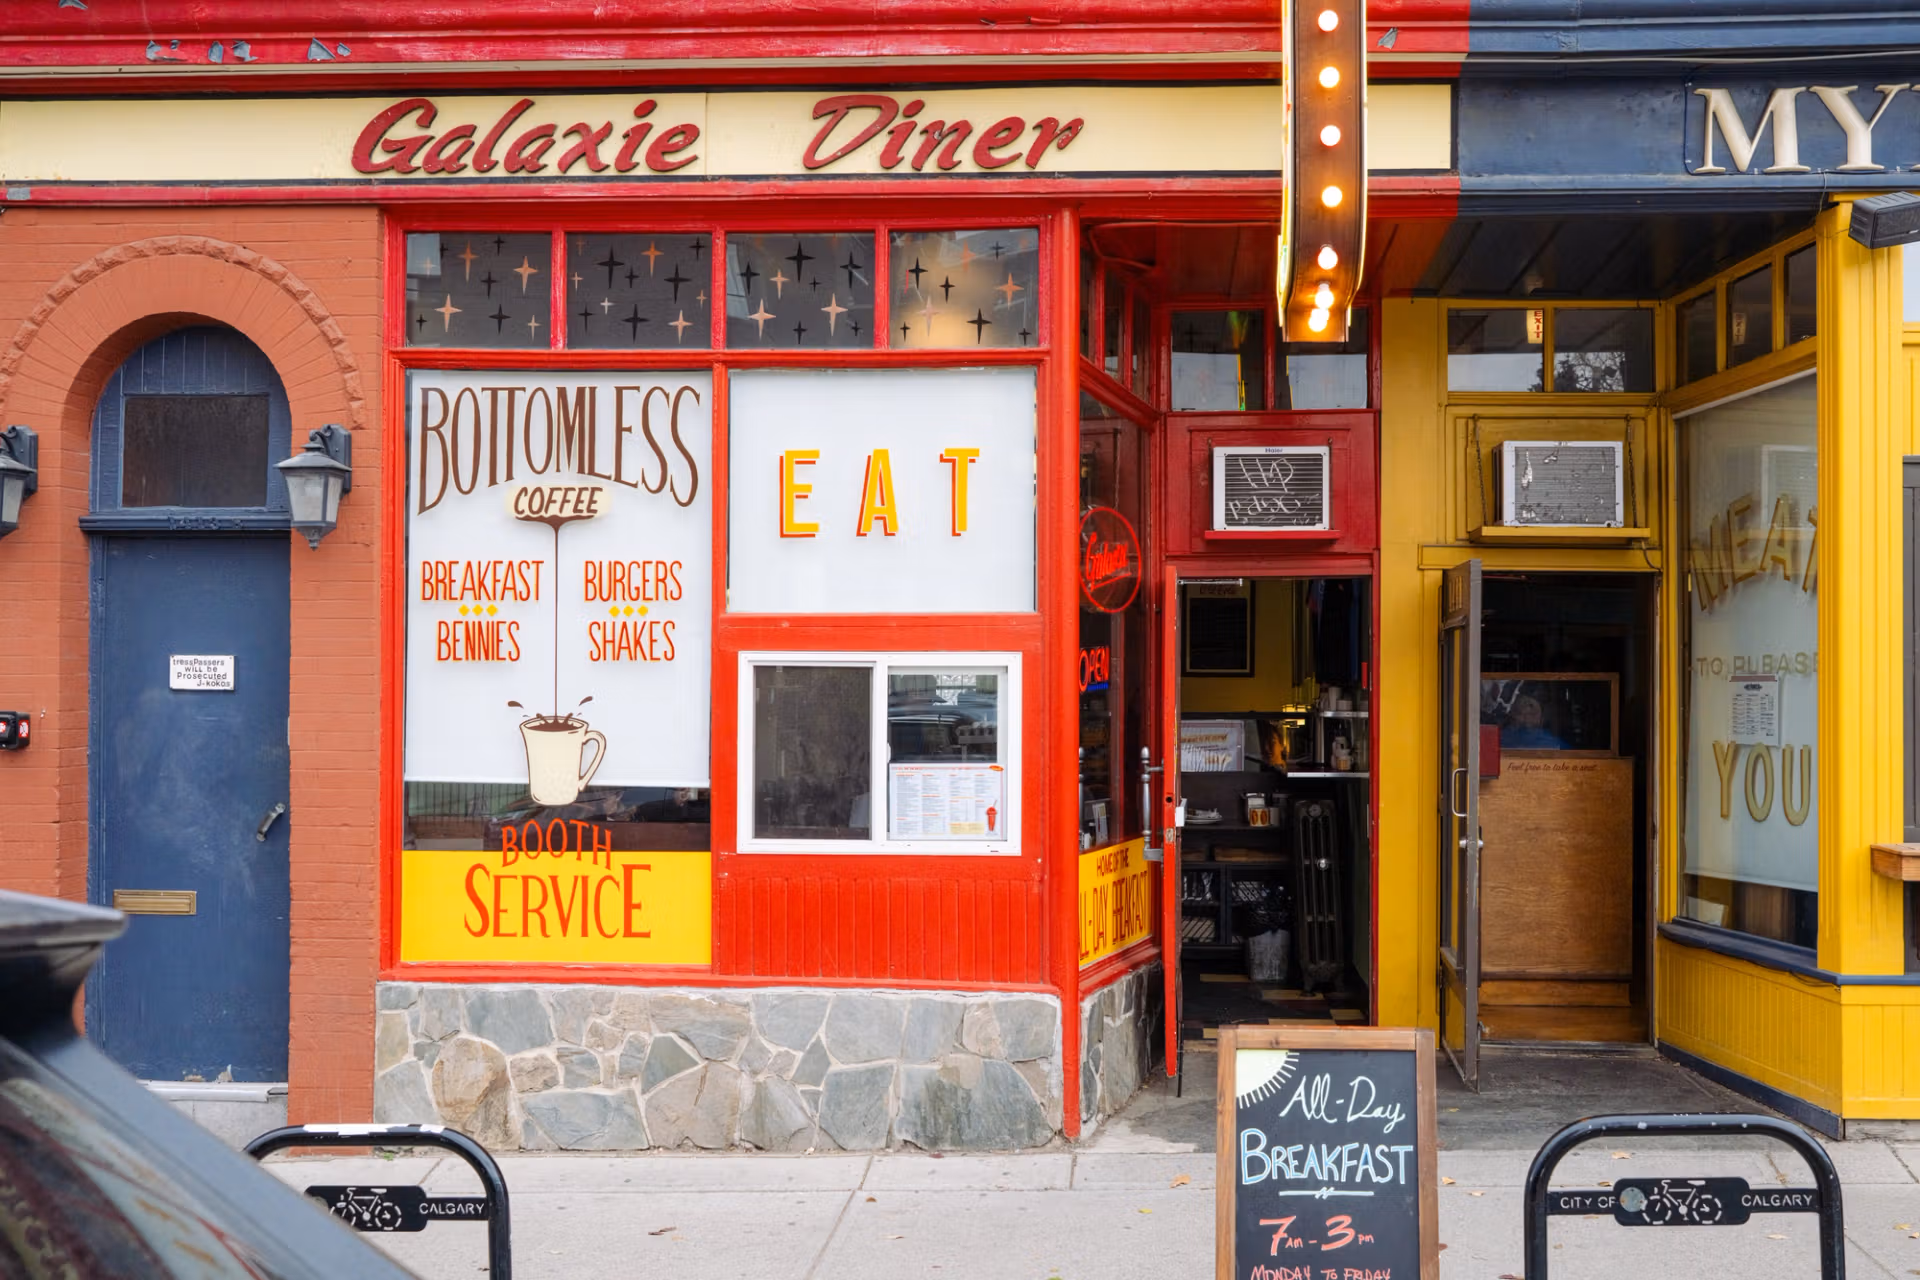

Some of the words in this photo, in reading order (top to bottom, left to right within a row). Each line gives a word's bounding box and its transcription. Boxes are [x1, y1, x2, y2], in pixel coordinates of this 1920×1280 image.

[351, 97, 700, 174] Galaxie
[802, 94, 1084, 170] Diner
[1694, 84, 1920, 174] MY
[1533, 310, 1543, 339] EXIT
[417, 385, 701, 516] BOTTOMLESS
[513, 486, 603, 516] COFFEE
[778, 448, 980, 538] EAT
[421, 560, 545, 602] BREAKFAST
[584, 560, 683, 602] BURGERS
[436, 620, 521, 662] BENNIES
[588, 620, 676, 662] SHAKES
[177, 672, 227, 680] Prosecuted
[1079, 647, 1110, 692] OPEN
[1696, 656, 1724, 677] TO
[1553, 762, 1570, 772] take
[1712, 740, 1812, 827] YOU
[501, 818, 612, 870] BOOTH
[1096, 855, 1112, 876] HOME
[464, 863, 652, 939] SERVICE
[1079, 883, 1109, 960] LL-DAY
[1113, 870, 1148, 945] BREAKFAST
[1279, 1073, 1406, 1133] All-Day
[1241, 1128, 1414, 1185] BREAKFAST
[418, 1202, 485, 1215] CALGARY
[1560, 1197, 1593, 1209] CITY
[1597, 1197, 1616, 1208] OF
[1741, 1194, 1813, 1207] CALGARY
[1251, 1264, 1311, 1280] MONDAY
